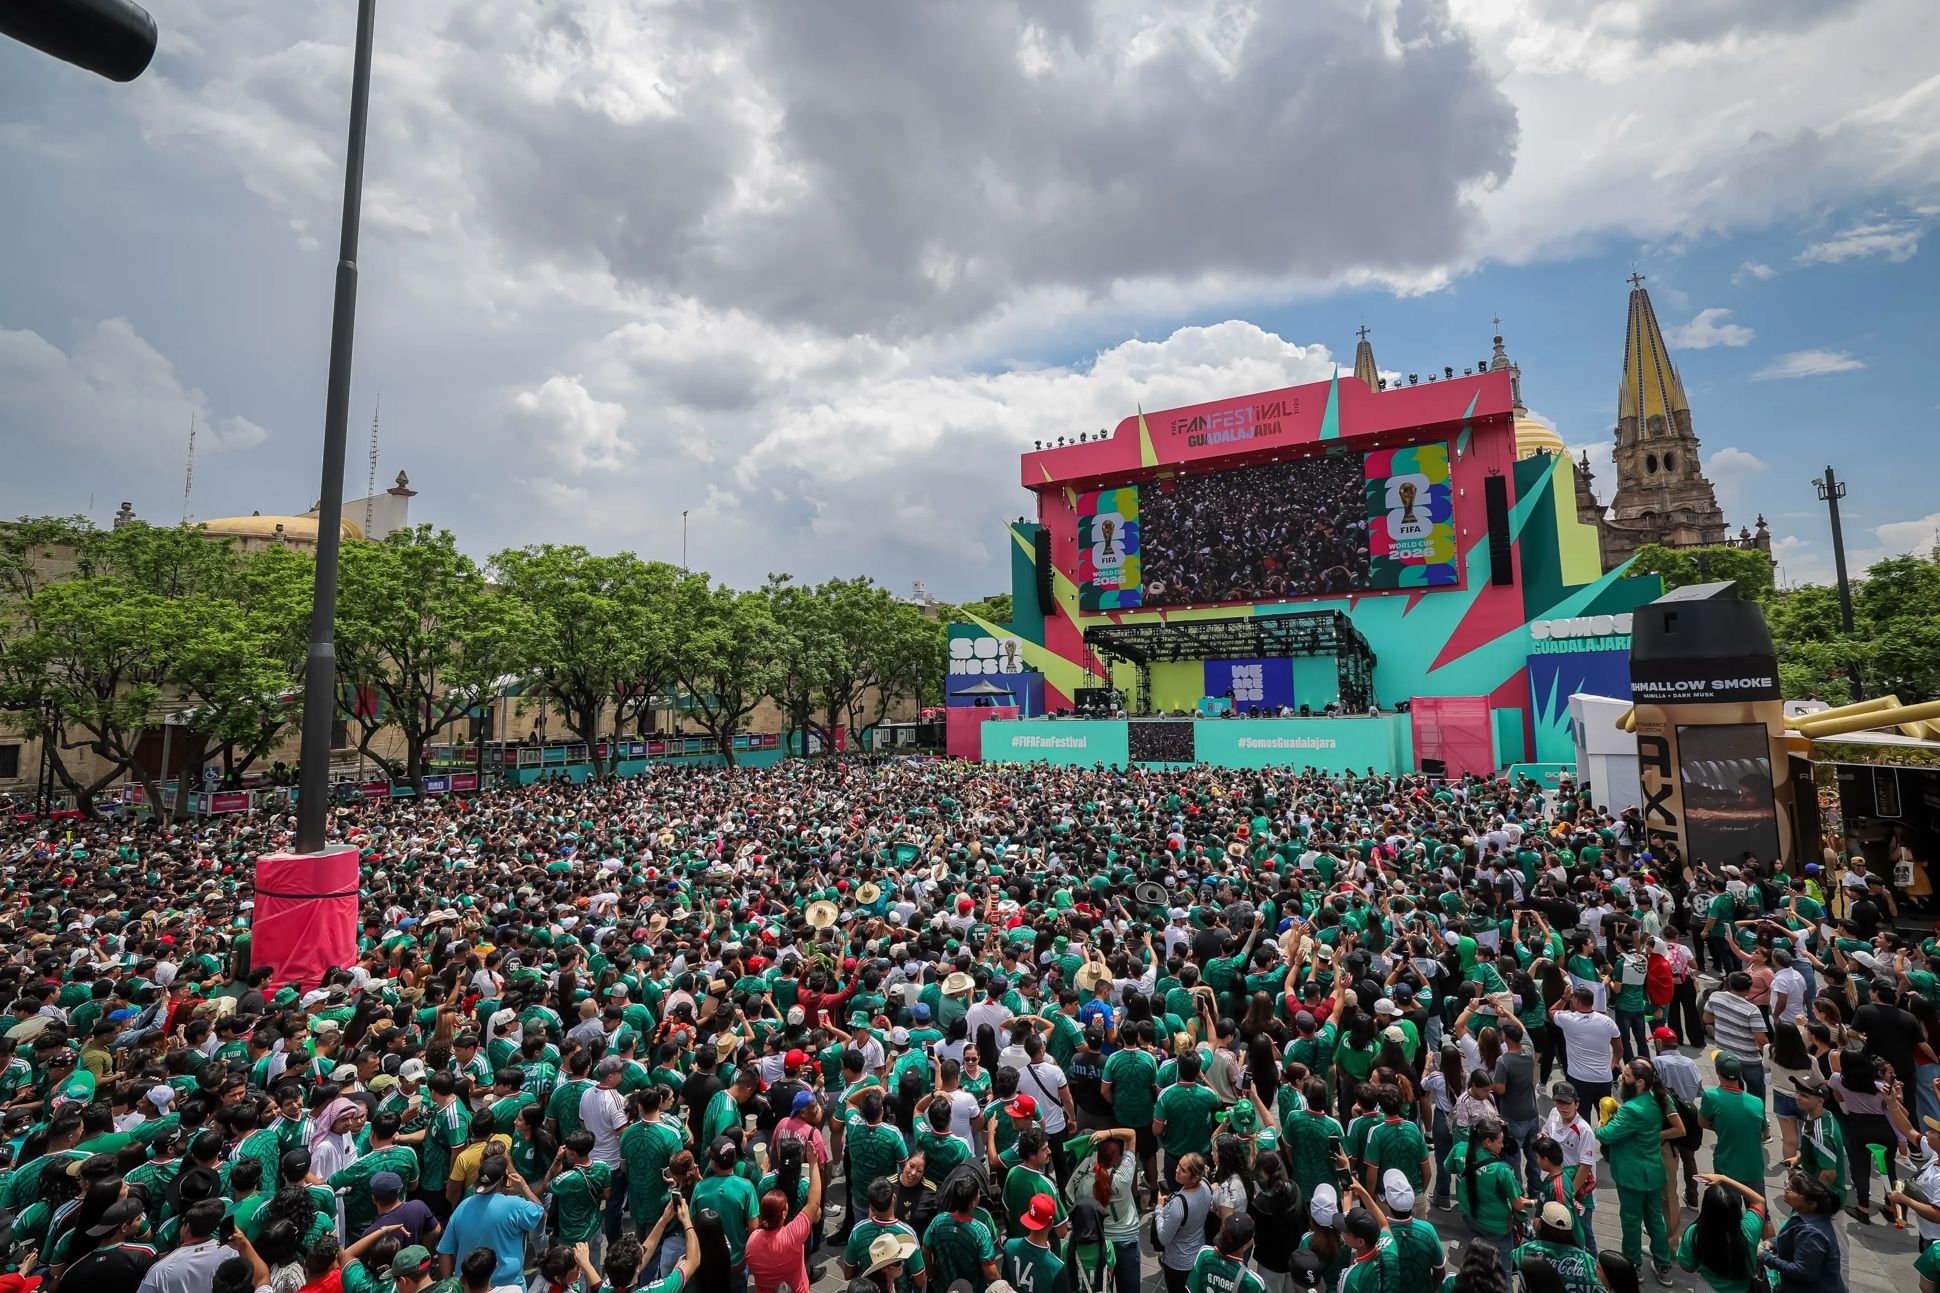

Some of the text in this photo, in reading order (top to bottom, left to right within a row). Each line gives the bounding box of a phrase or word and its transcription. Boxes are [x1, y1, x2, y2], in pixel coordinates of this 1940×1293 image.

[1188, 421, 1282, 448] GUADALAJARA
[1400, 525, 1421, 534] FIFA
[1388, 541, 1417, 550] WORLD
[1101, 556, 1117, 564] FIFA
[1388, 547, 1435, 560] 2026
[1092, 576, 1127, 586] 2026
[1530, 613, 1633, 639] SOMOS
[1533, 636, 1631, 654] GUADALAJAR
[1711, 677, 1772, 690] SMOKE
[1011, 735, 1087, 748] #FIFAFanFestival
[1238, 737, 1336, 750] #SomosGuadalajara
[1637, 735, 1679, 841] AX
[1613, 921, 1628, 937] 17
[1013, 1255, 1034, 1293] 14
